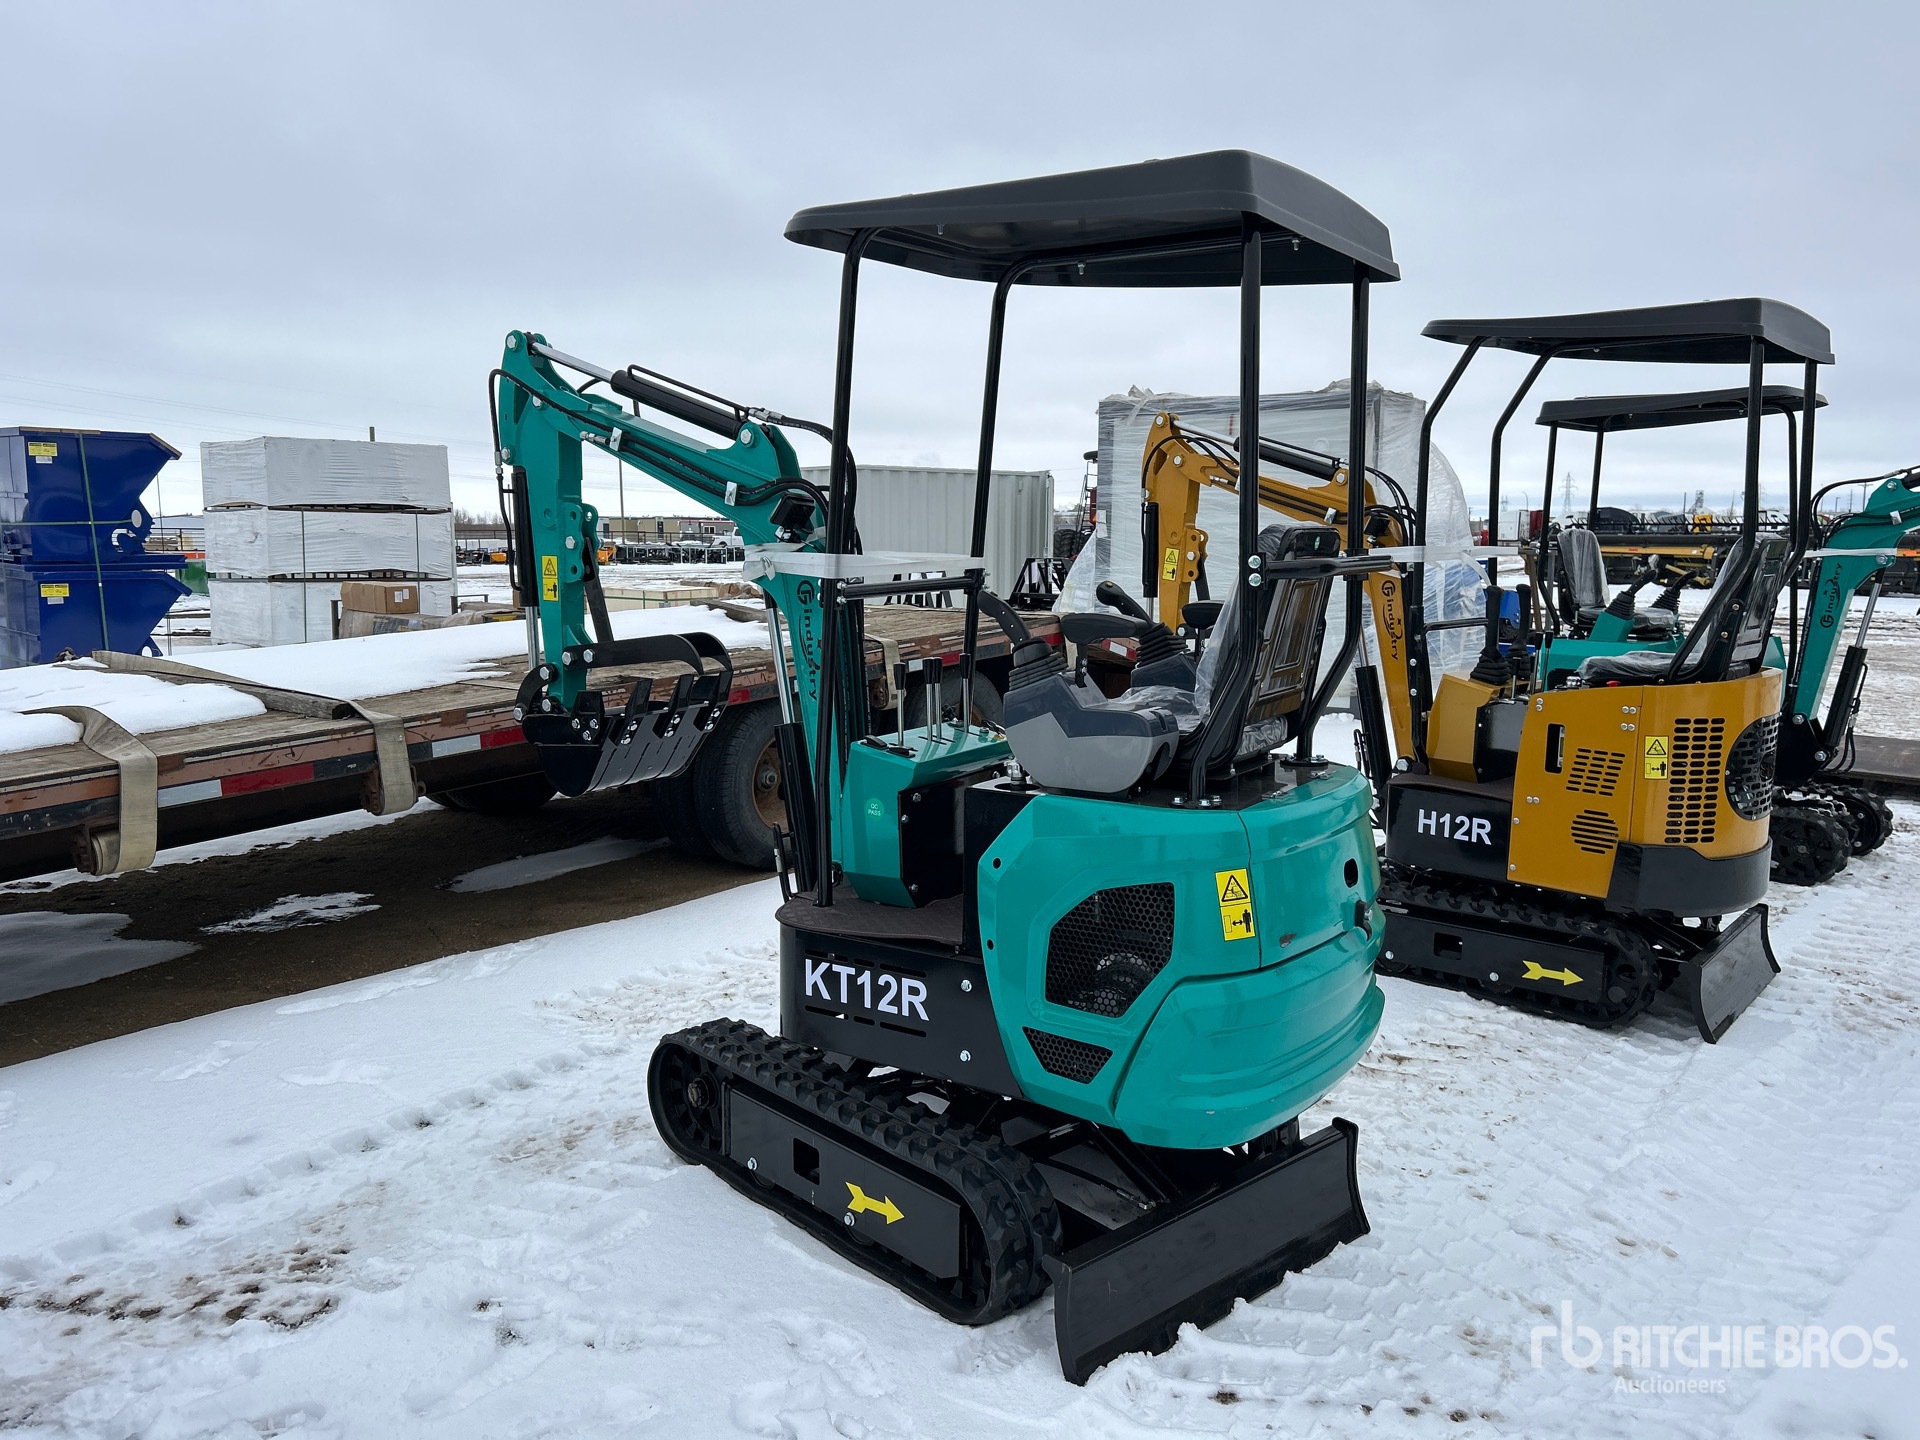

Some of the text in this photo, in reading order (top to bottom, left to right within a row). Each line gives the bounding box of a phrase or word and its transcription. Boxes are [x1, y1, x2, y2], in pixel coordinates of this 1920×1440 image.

[867, 809, 881, 817] PASS
[1418, 808, 1492, 845] H12R
[805, 958, 930, 1021] KT12R
